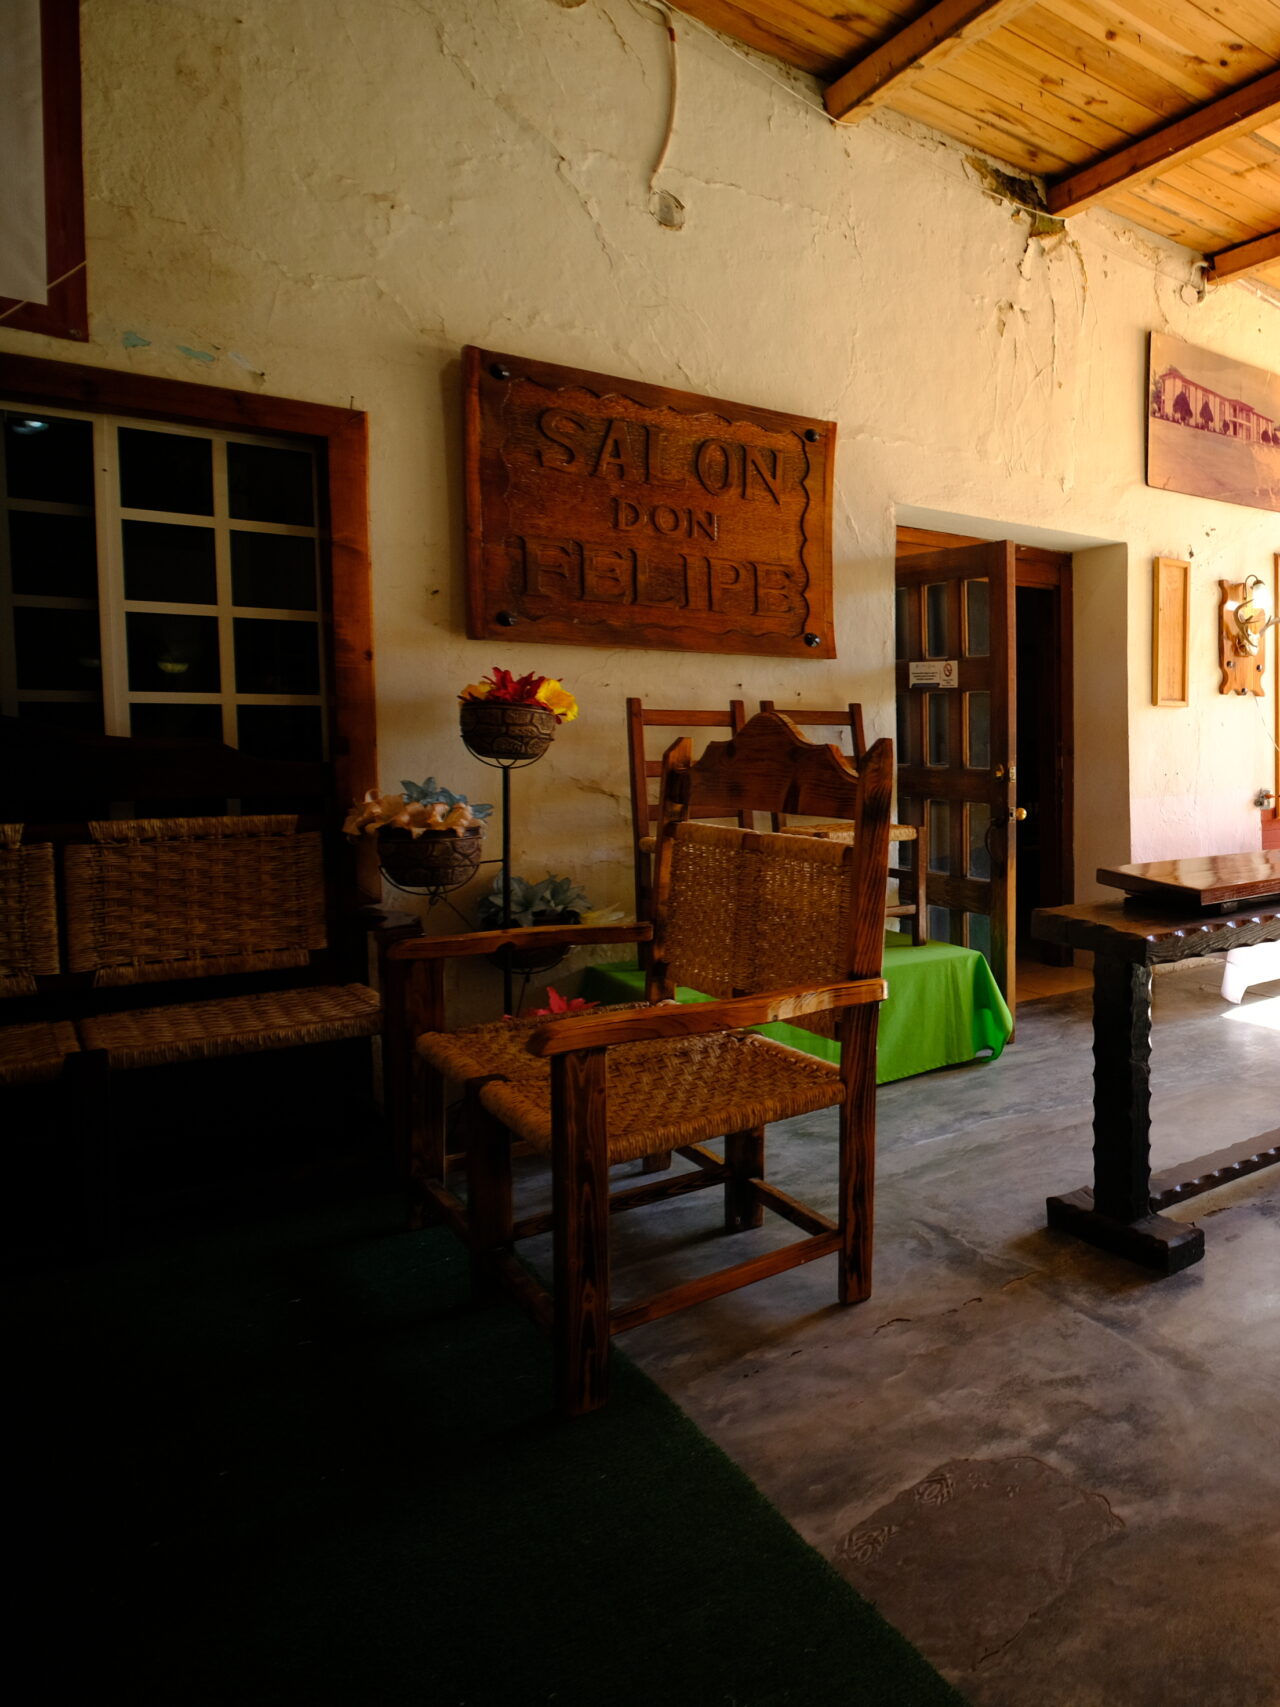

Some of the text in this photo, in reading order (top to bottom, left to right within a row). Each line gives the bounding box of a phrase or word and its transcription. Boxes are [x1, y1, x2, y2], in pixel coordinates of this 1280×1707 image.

[536, 407, 785, 504] SALON
[612, 498, 719, 541] DON
[514, 535, 795, 616] FELIPE
